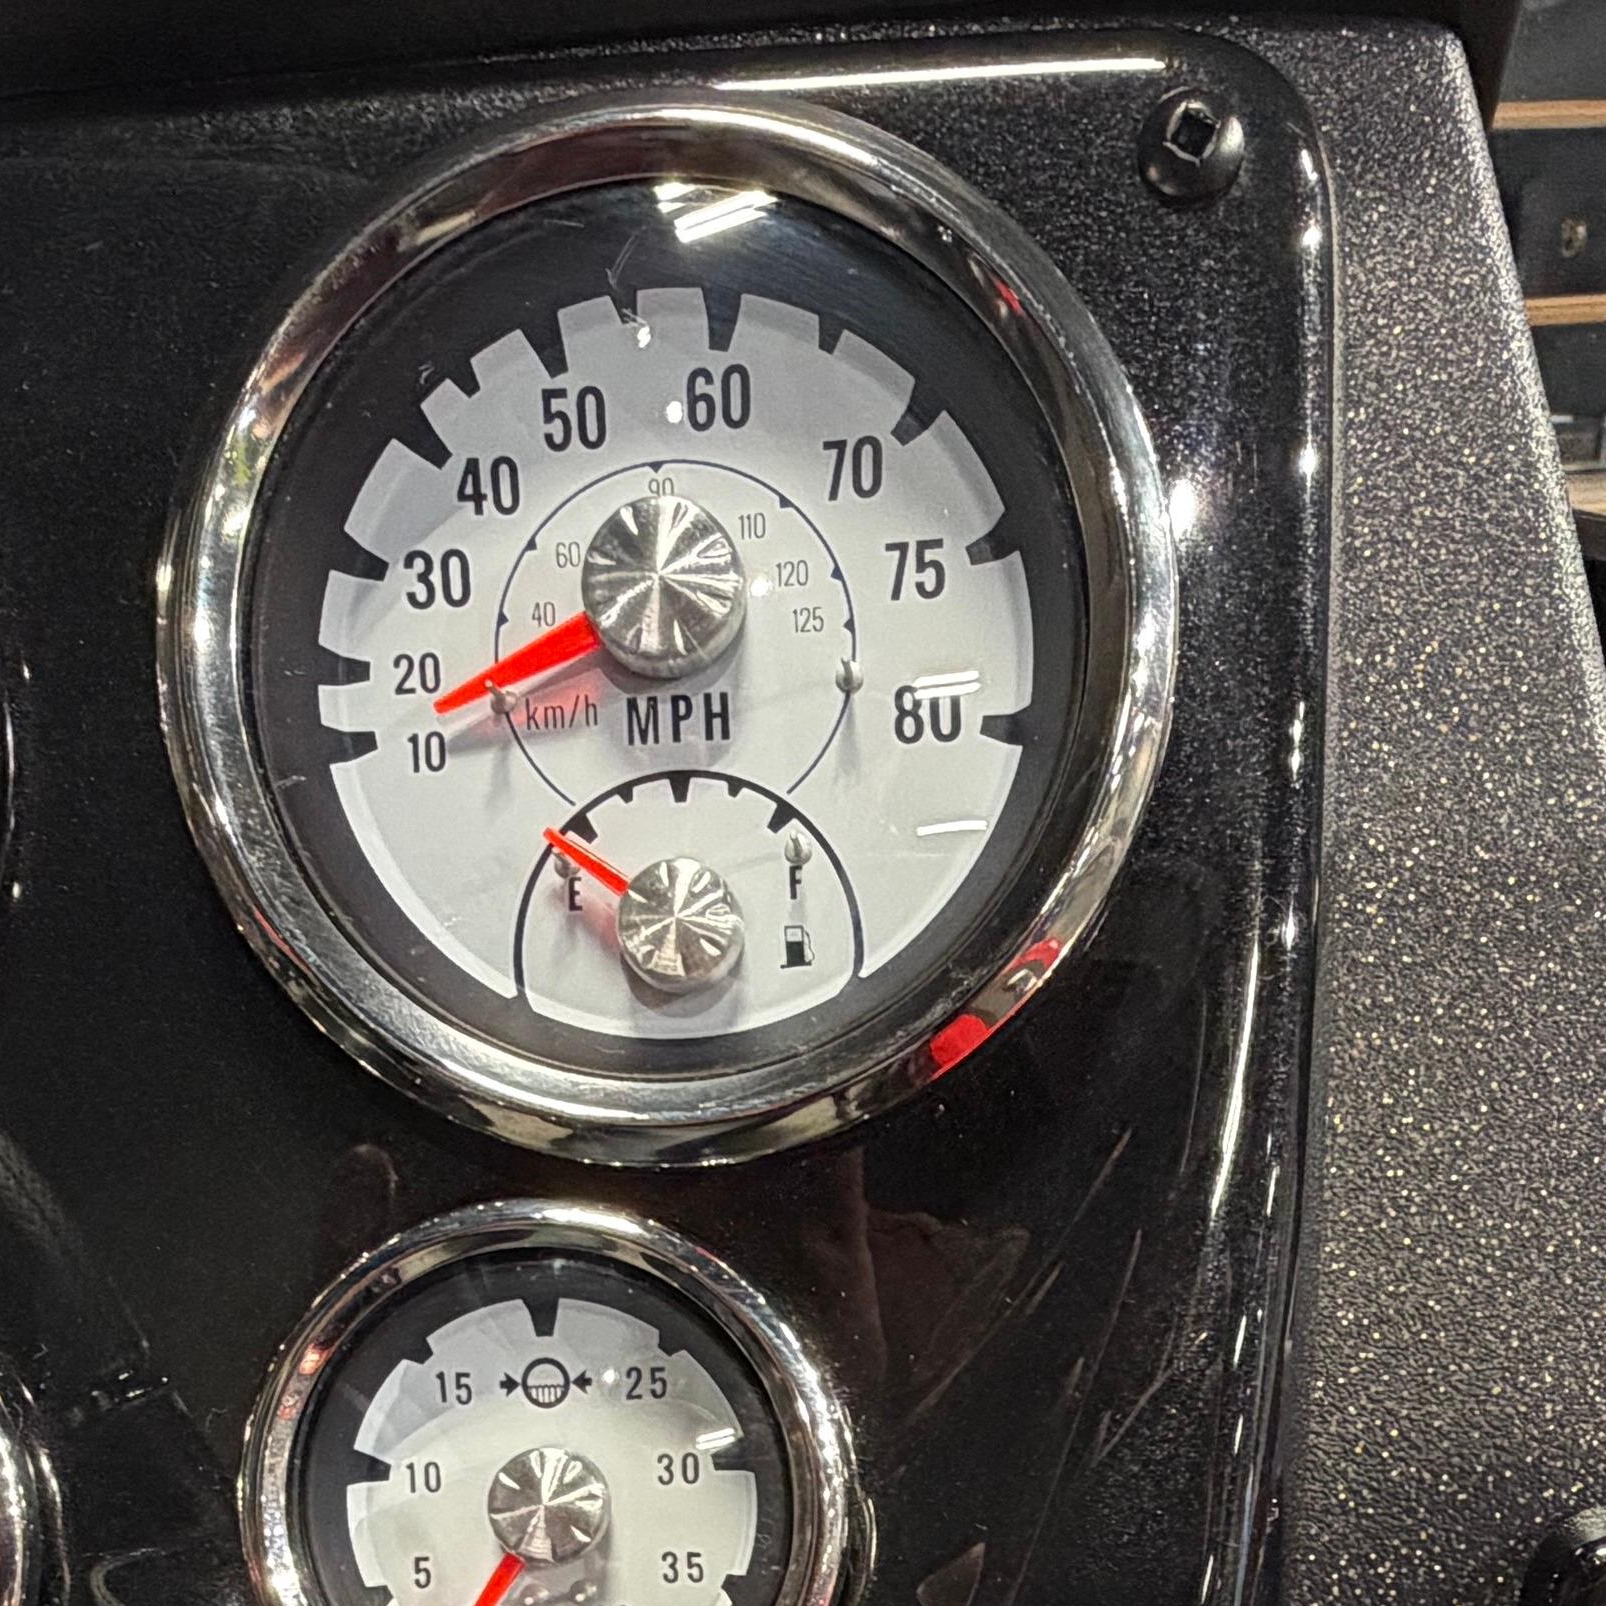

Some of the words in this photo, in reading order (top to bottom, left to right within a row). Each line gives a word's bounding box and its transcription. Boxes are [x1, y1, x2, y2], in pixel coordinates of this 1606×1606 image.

[687, 364, 750, 431] 60
[542, 386, 606, 451] 50
[457, 456, 519, 515] 40
[823, 436, 882, 500] 70
[648, 477, 675, 497] 90
[739, 513, 765, 539] 110
[554, 540, 583, 571] 60
[776, 560, 808, 586] 120
[886, 538, 945, 600] 75
[404, 549, 470, 609] 30
[530, 600, 559, 630] 40
[793, 607, 824, 632] 125
[391, 652, 443, 698] 20
[524, 693, 601, 733] km/h
[627, 692, 729, 745] MPH
[893, 683, 965, 747] 80
[408, 732, 446, 772] 10
[567, 876, 585, 912] E
[788, 864, 804, 901] F
[436, 1372, 472, 1404] 15
[626, 1367, 667, 1399] 25
[407, 1462, 441, 1493] 10
[658, 1453, 699, 1485] 30
[415, 1557, 431, 1588] 5
[662, 1552, 703, 1583] 35
